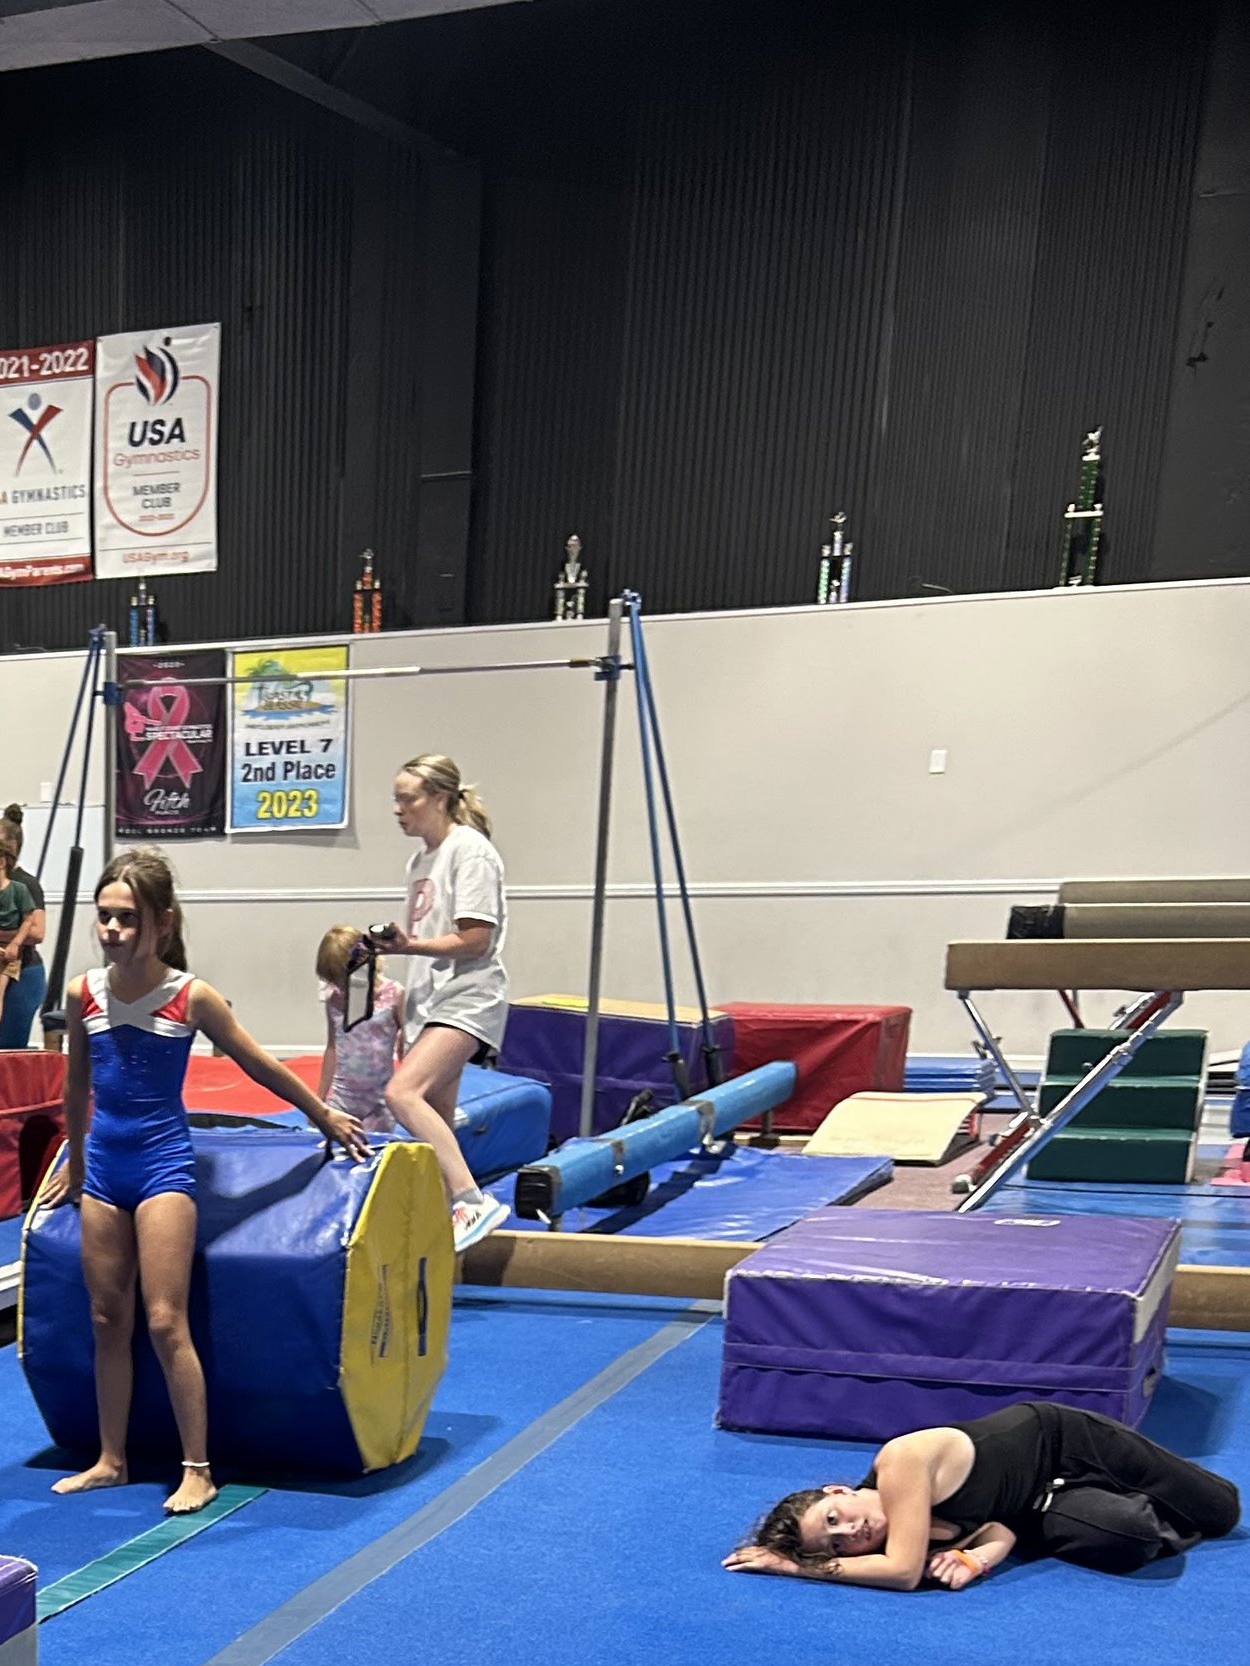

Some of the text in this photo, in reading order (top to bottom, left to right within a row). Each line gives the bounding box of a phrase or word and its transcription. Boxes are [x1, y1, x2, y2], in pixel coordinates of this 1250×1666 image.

[128, 417, 186, 447] USA
[113, 449, 200, 469] Gymnastics
[133, 483, 180, 496] MEMBER
[142, 497, 172, 509] CLUB
[3, 521, 69, 537] MEMBER CLUB
[245, 738, 333, 757] LEVEL 7
[241, 761, 336, 783] 2nd Place
[257, 789, 318, 819] 2023
